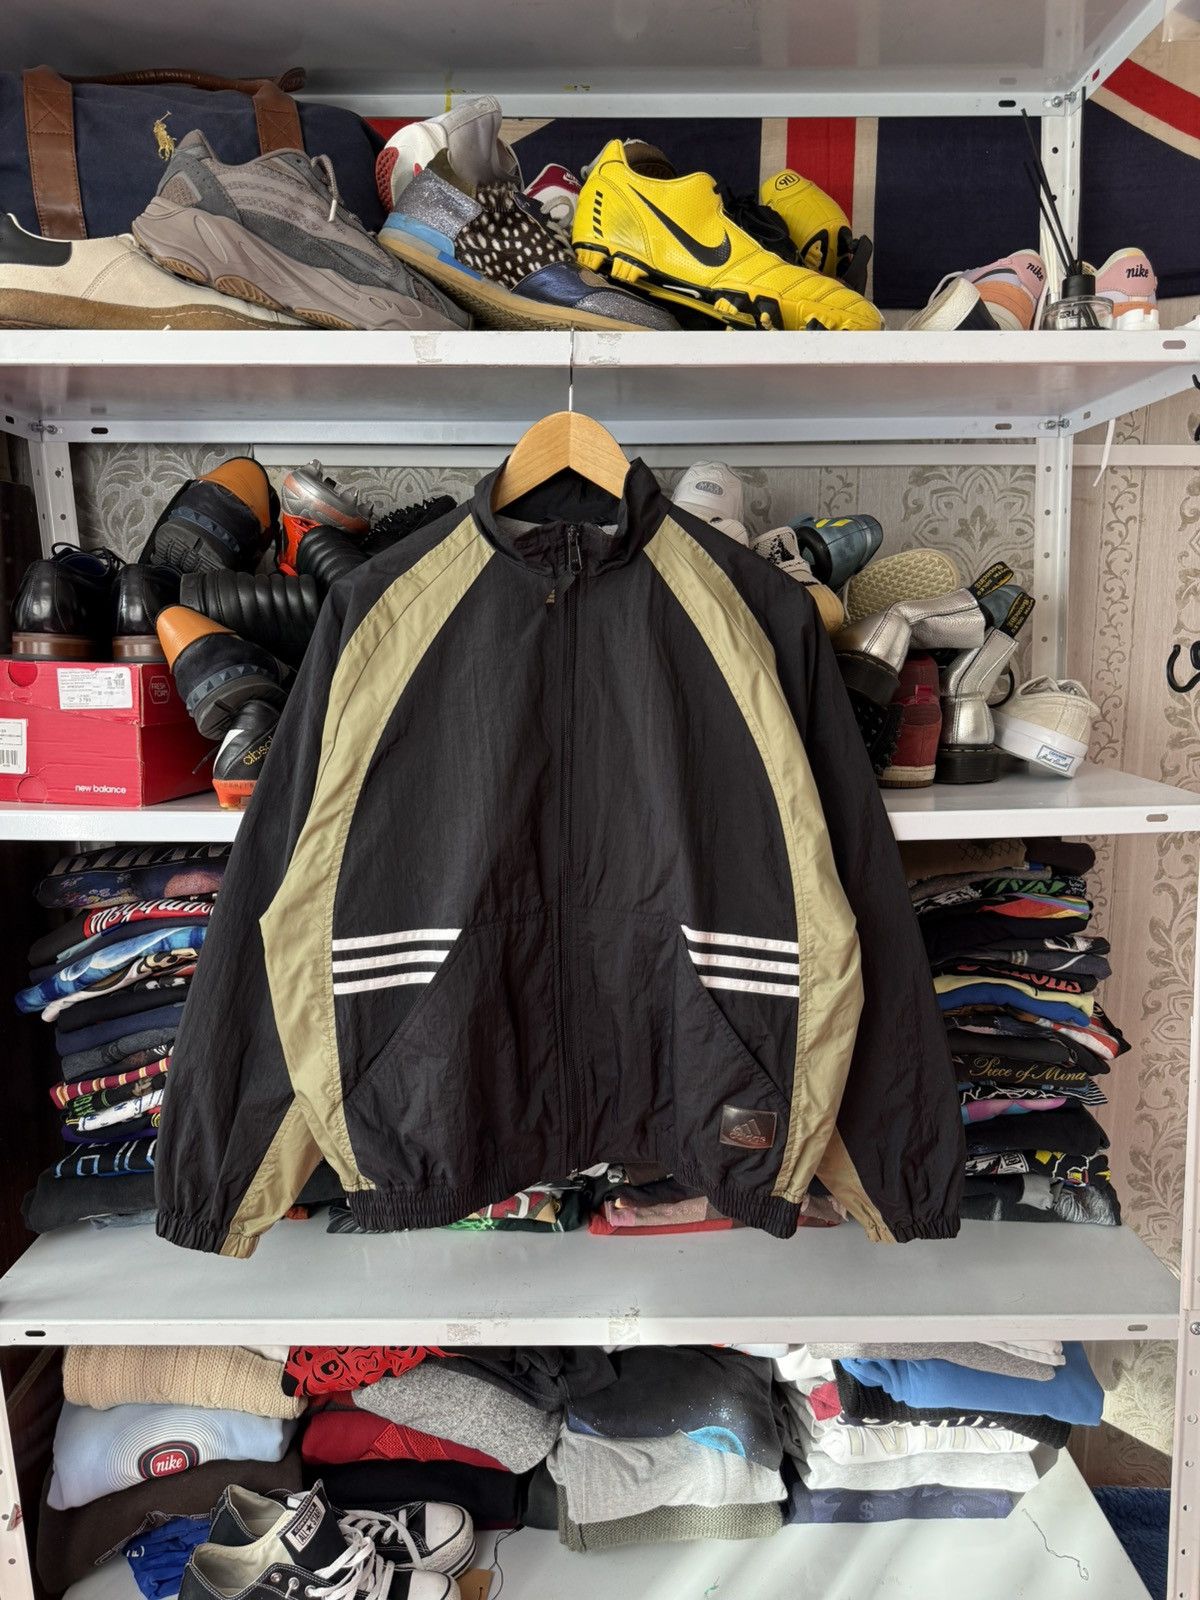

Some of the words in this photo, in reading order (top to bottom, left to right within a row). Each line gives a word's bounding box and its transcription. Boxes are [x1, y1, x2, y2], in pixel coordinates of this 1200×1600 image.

[1026, 262, 1044, 281] nike
[1126, 264, 1149, 278] nike
[243, 735, 273, 765] abso
[75, 784, 91, 793] new
[92, 784, 127, 794] balance
[969, 1058, 1012, 1077] Piece
[1015, 1064, 1038, 1084] of
[156, 1454, 183, 1473] nike
[298, 1529, 310, 1543] ALL
